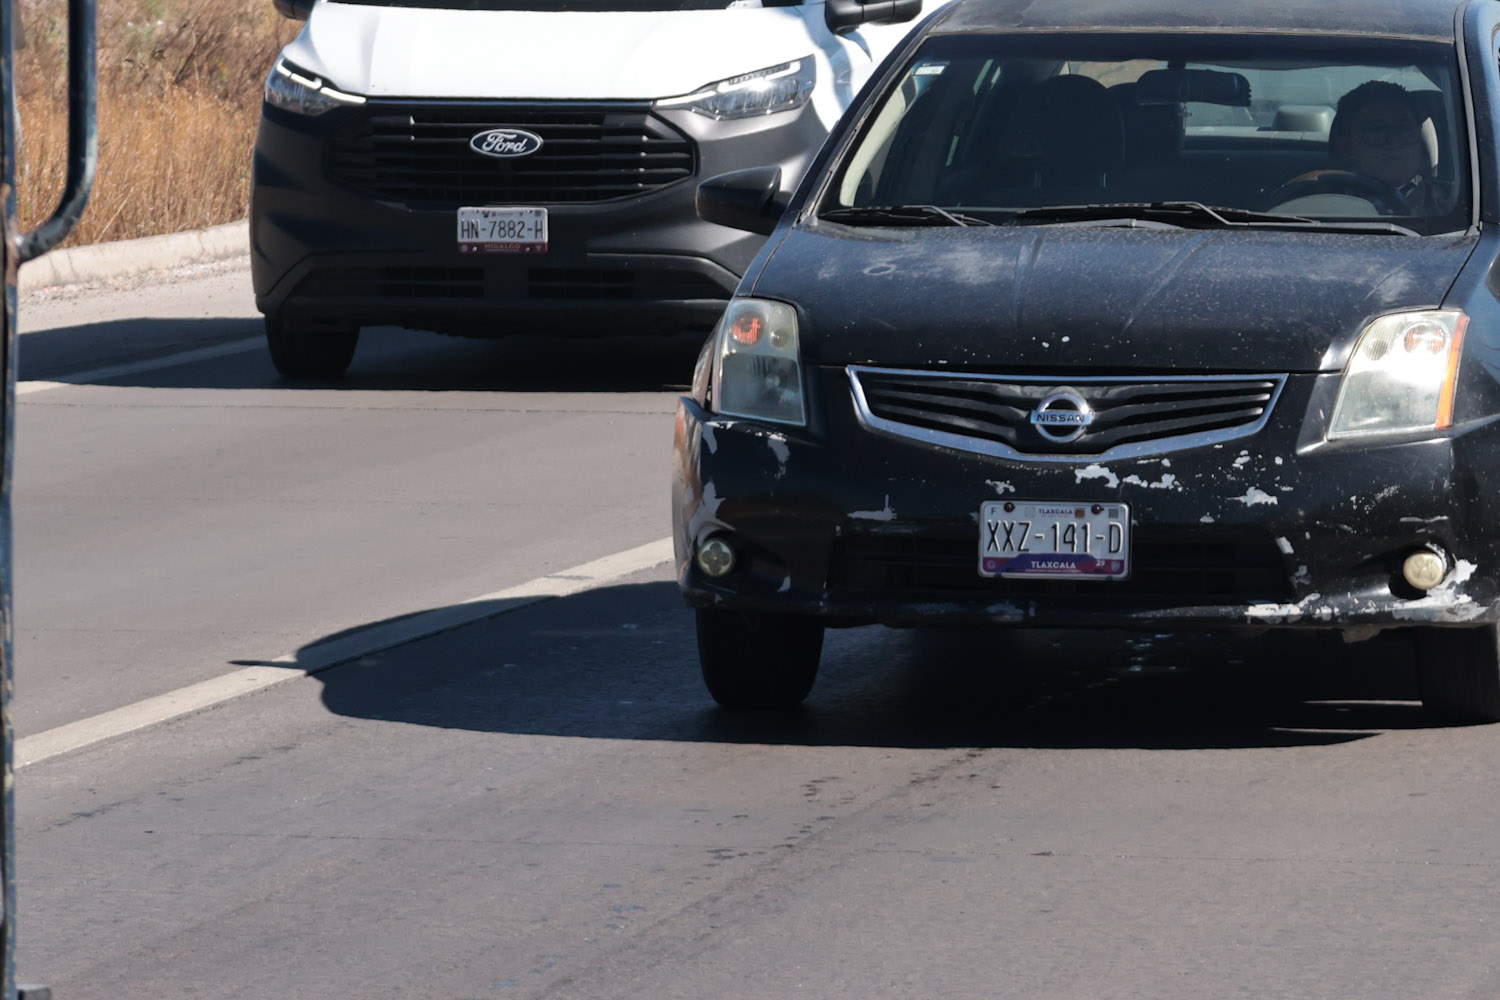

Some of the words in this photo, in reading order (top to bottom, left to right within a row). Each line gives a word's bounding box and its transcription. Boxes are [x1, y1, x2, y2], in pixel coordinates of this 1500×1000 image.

[482, 132, 528, 153] Ford
[461, 219, 543, 239] HN-7882-H
[484, 242, 521, 250] HIDALGO
[1036, 413, 1085, 423] NISSAN
[987, 520, 1124, 554] XXZ-141-D
[1030, 560, 1076, 569] TLAXCALA
